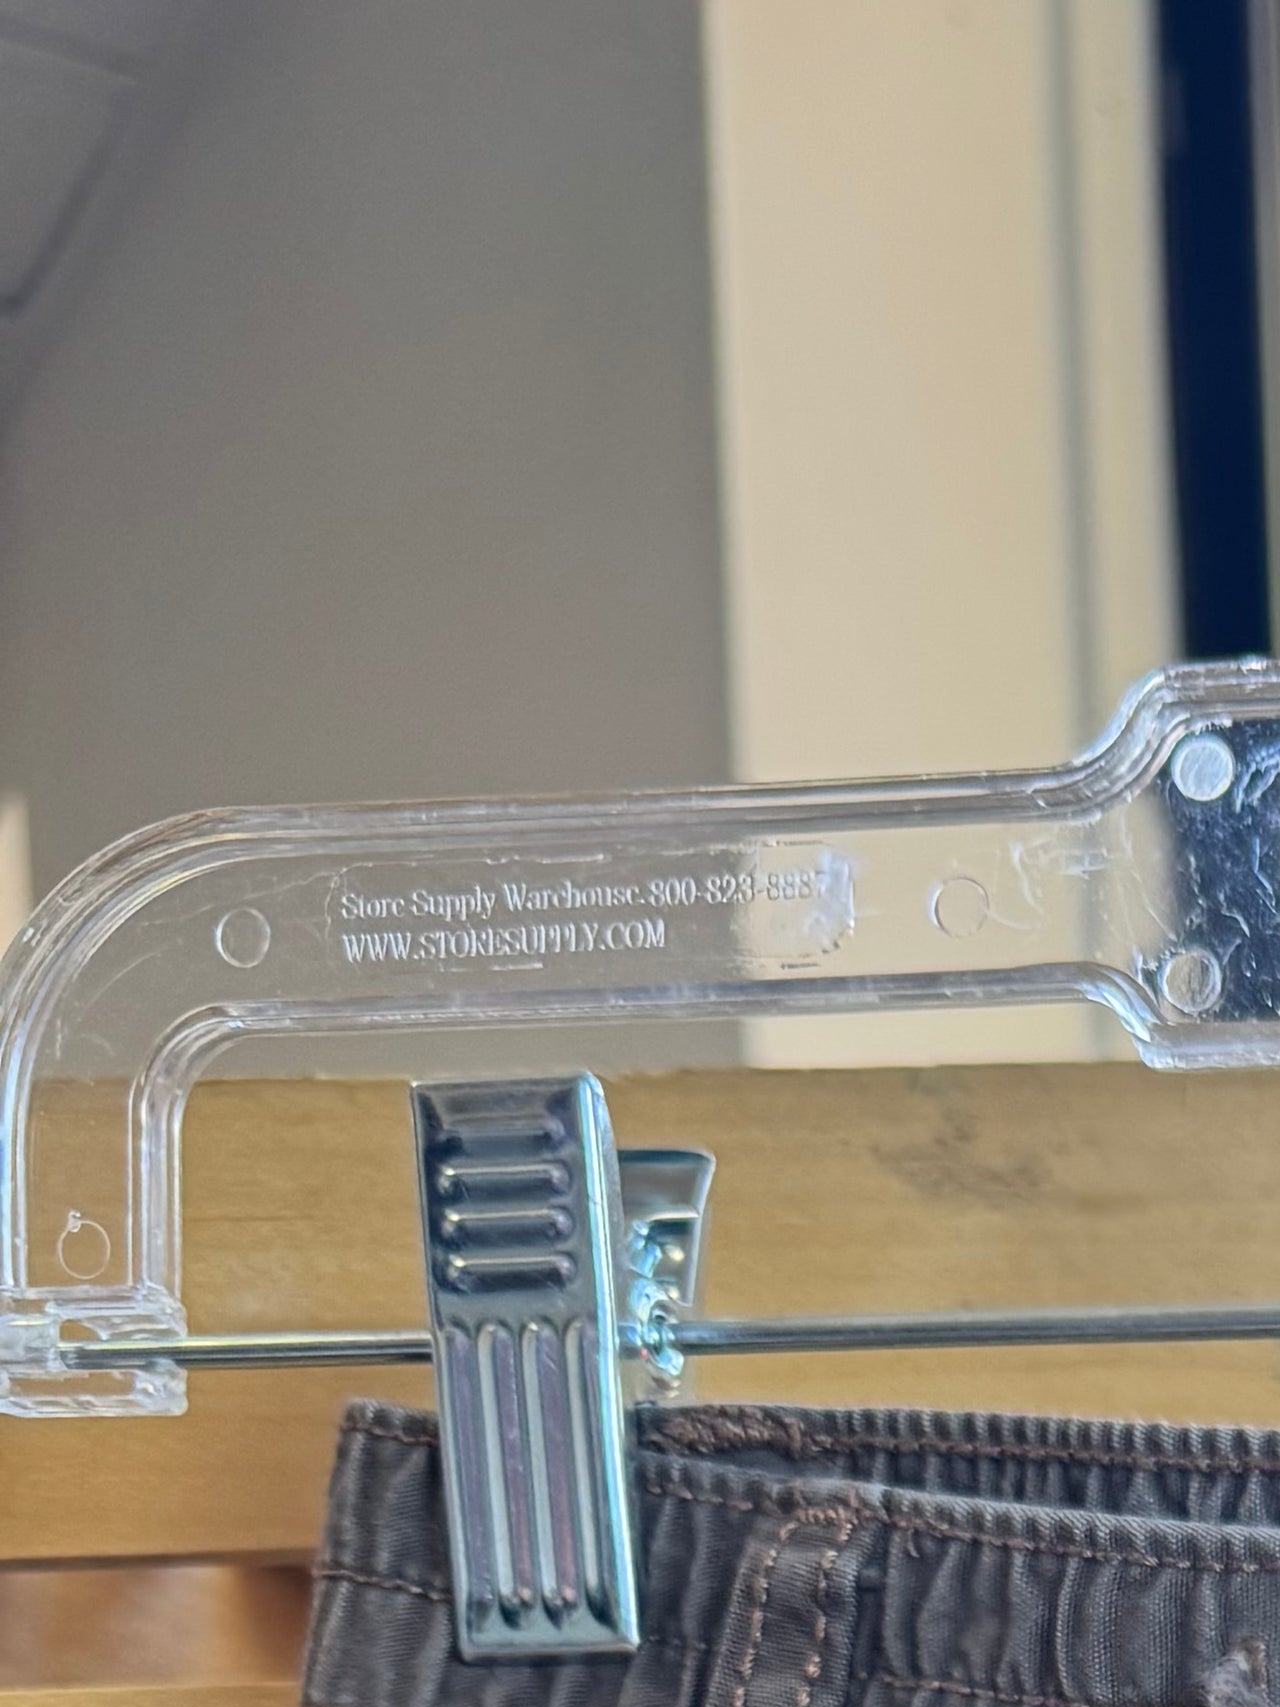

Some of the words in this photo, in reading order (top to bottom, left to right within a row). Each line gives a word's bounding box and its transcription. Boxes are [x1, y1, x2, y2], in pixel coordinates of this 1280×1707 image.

[341, 892, 405, 920] Store
[410, 883, 496, 922] Supply
[342, 917, 665, 964] WWW.STORESUPPLY.COM
